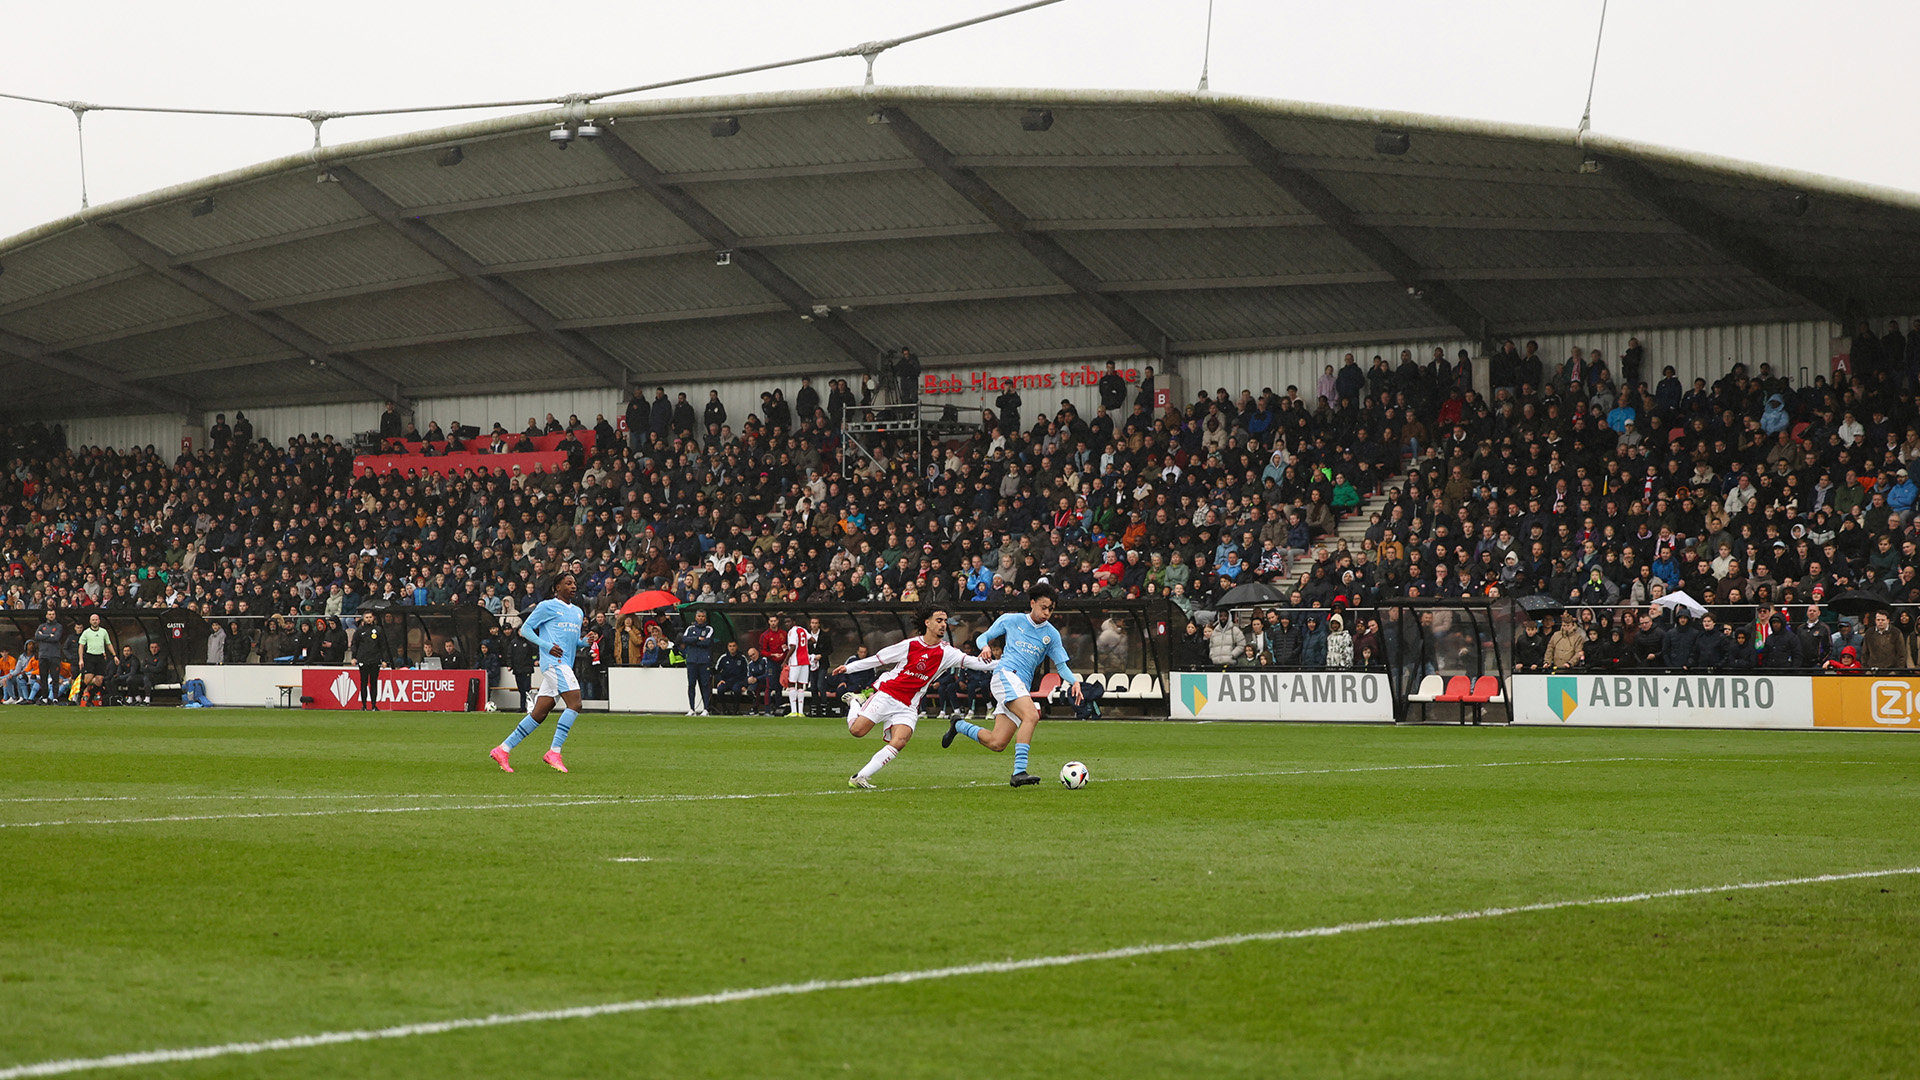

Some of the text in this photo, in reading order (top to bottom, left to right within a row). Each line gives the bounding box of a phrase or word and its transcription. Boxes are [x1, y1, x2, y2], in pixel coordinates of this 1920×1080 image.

[925, 373, 963, 394] Bob
[971, 371, 1053, 391] Haarms
[1158, 393, 1166, 405] B
[800, 631, 806, 647] 6
[412, 680, 455, 691] FUTURE
[411, 691, 436, 703] CUP
